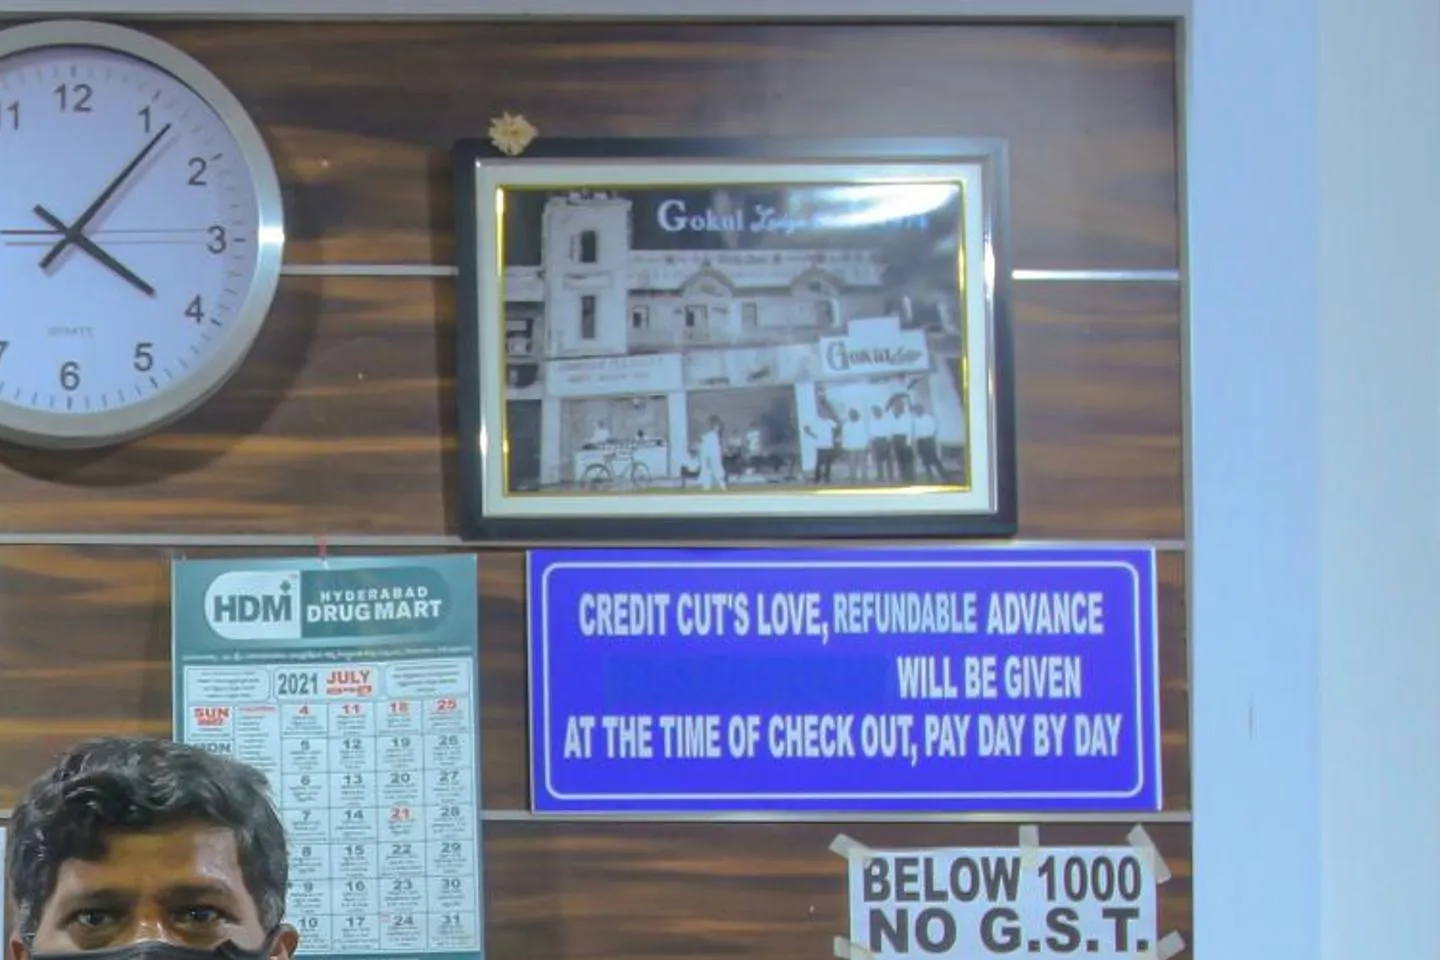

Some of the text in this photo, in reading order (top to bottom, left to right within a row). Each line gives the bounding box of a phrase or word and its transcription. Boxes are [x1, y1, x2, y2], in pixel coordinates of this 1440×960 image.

[54, 84, 93, 112] 12
[138, 107, 151, 133] 1
[187, 158, 207, 186] 2
[657, 200, 743, 232] Gokul
[207, 226, 227, 254] 3
[185, 296, 204, 323] 4
[133, 343, 153, 371] 5
[59, 361, 80, 391] 6
[320, 586, 428, 602] HYDERABAD
[214, 594, 292, 623] HDM
[579, 592, 1103, 645] CREDIT CUT'S LOVE, REFUNDABLE ADVANCE
[277, 672, 318, 695] 2021
[325, 670, 371, 685] JULY
[898, 655, 1082, 699] WILL BE GIVEN
[193, 708, 229, 719] SUN
[564, 714, 1123, 767] AT THE TIME OF CHECK OUT, PAY DAY BY DAY
[863, 856, 1142, 902] BELOW 1000
[869, 907, 1149, 954] NO G.S.T.
